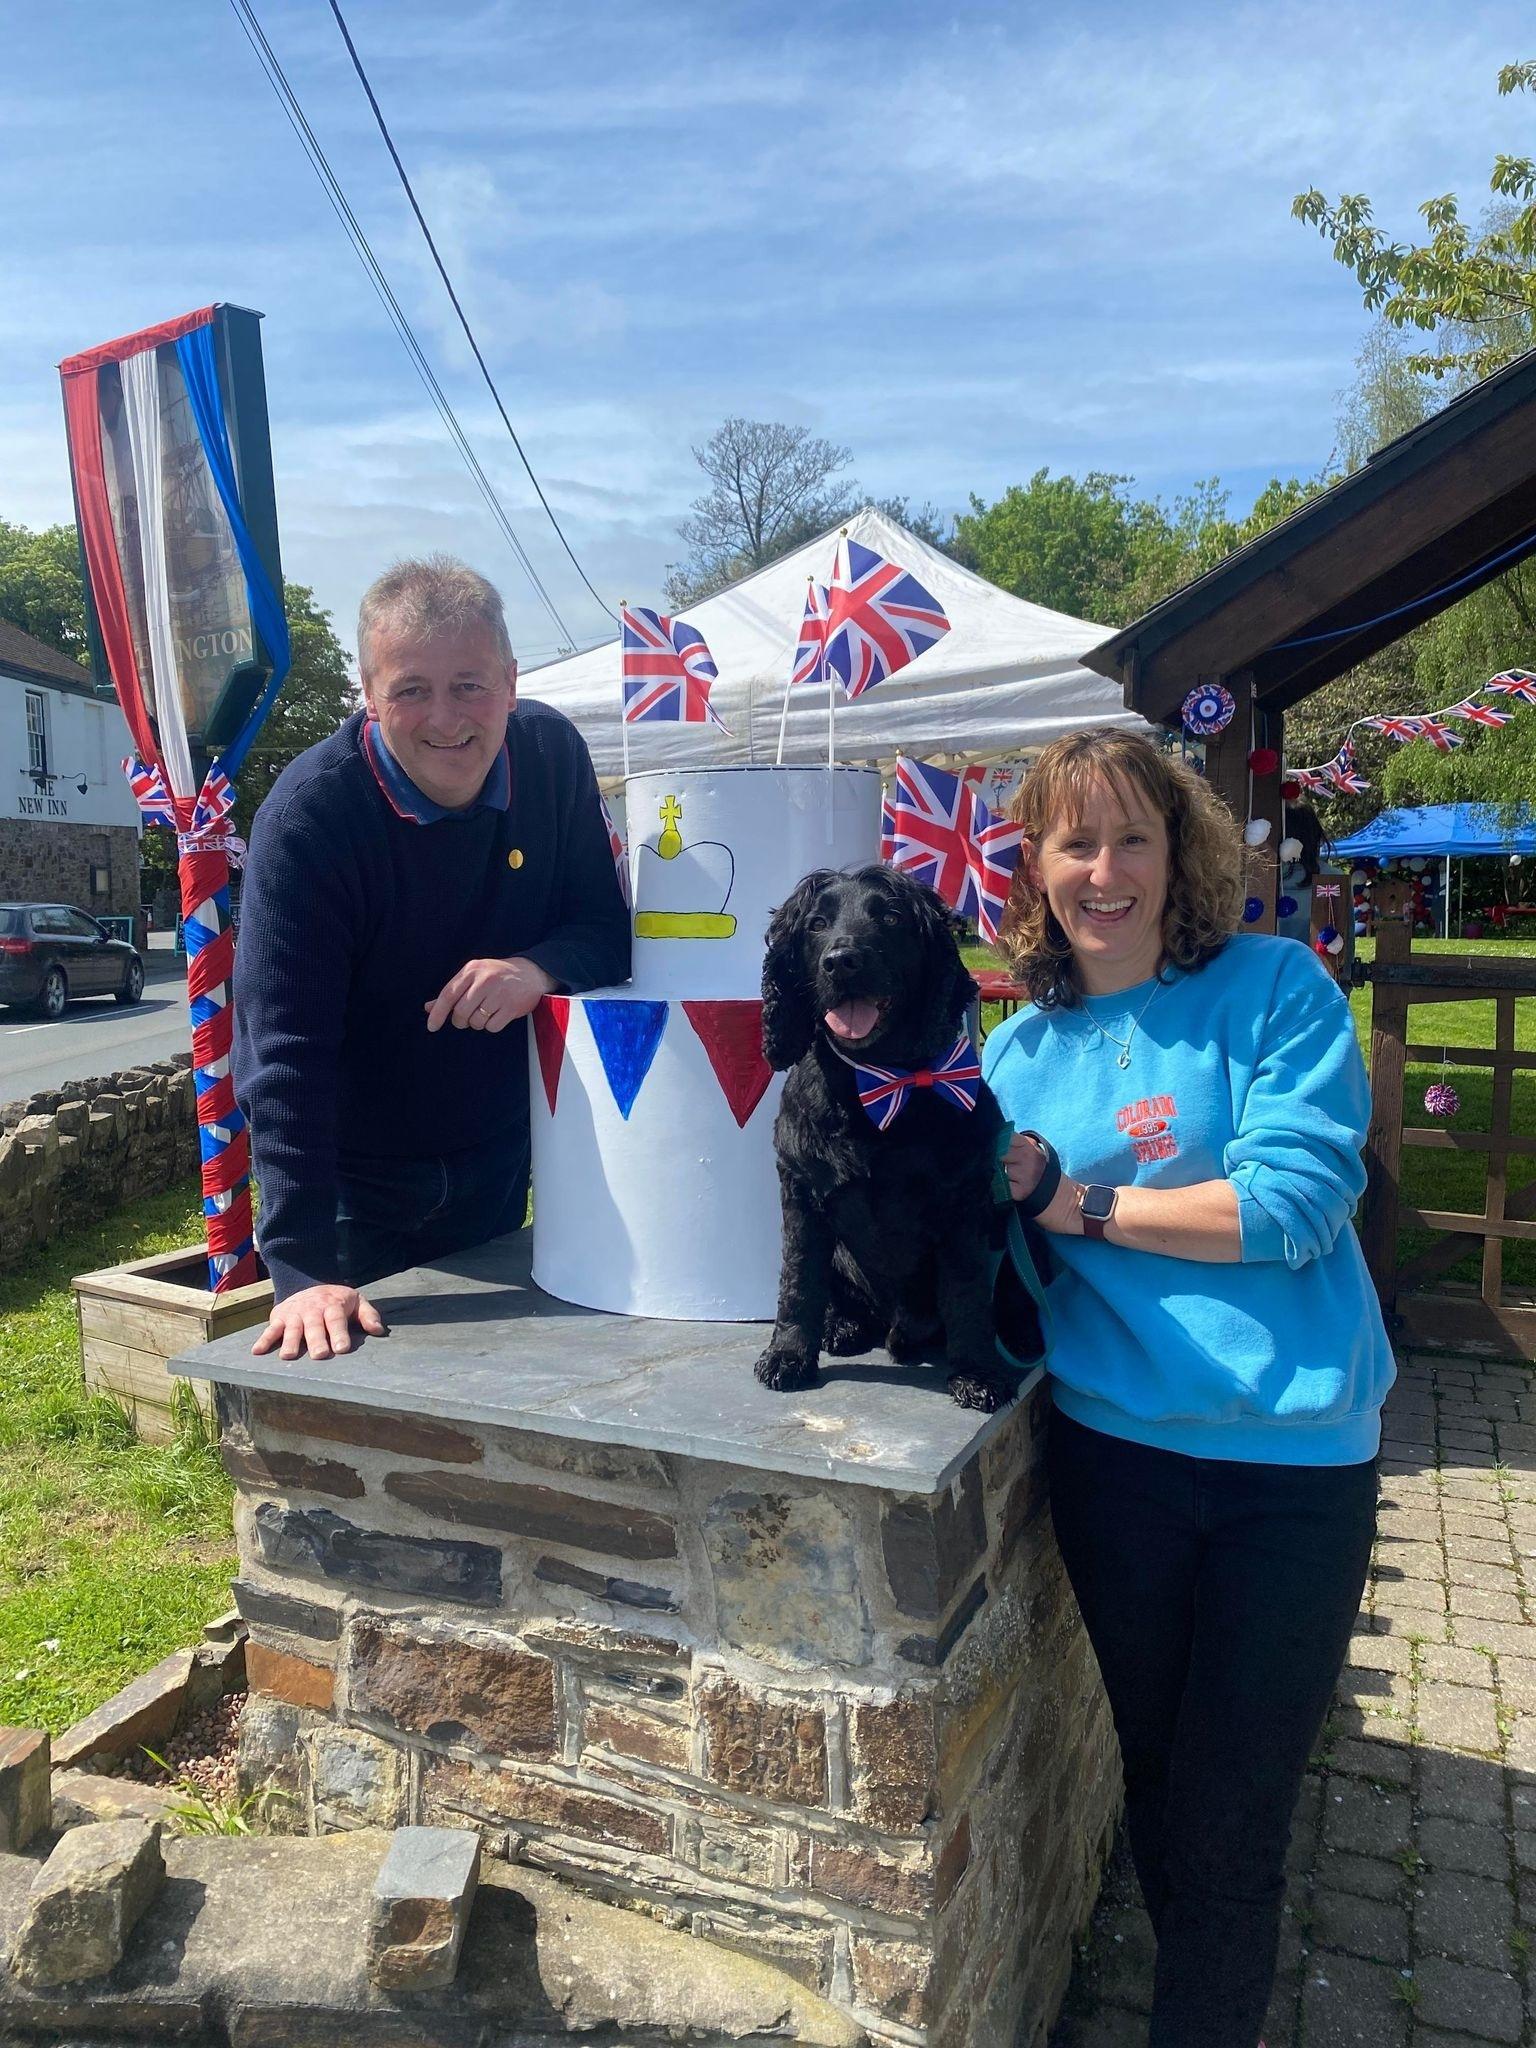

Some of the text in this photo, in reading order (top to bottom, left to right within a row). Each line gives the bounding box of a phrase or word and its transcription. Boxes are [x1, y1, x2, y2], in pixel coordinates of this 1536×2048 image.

[33, 779, 54, 796] THE
[18, 796, 67, 816] NEW INN
